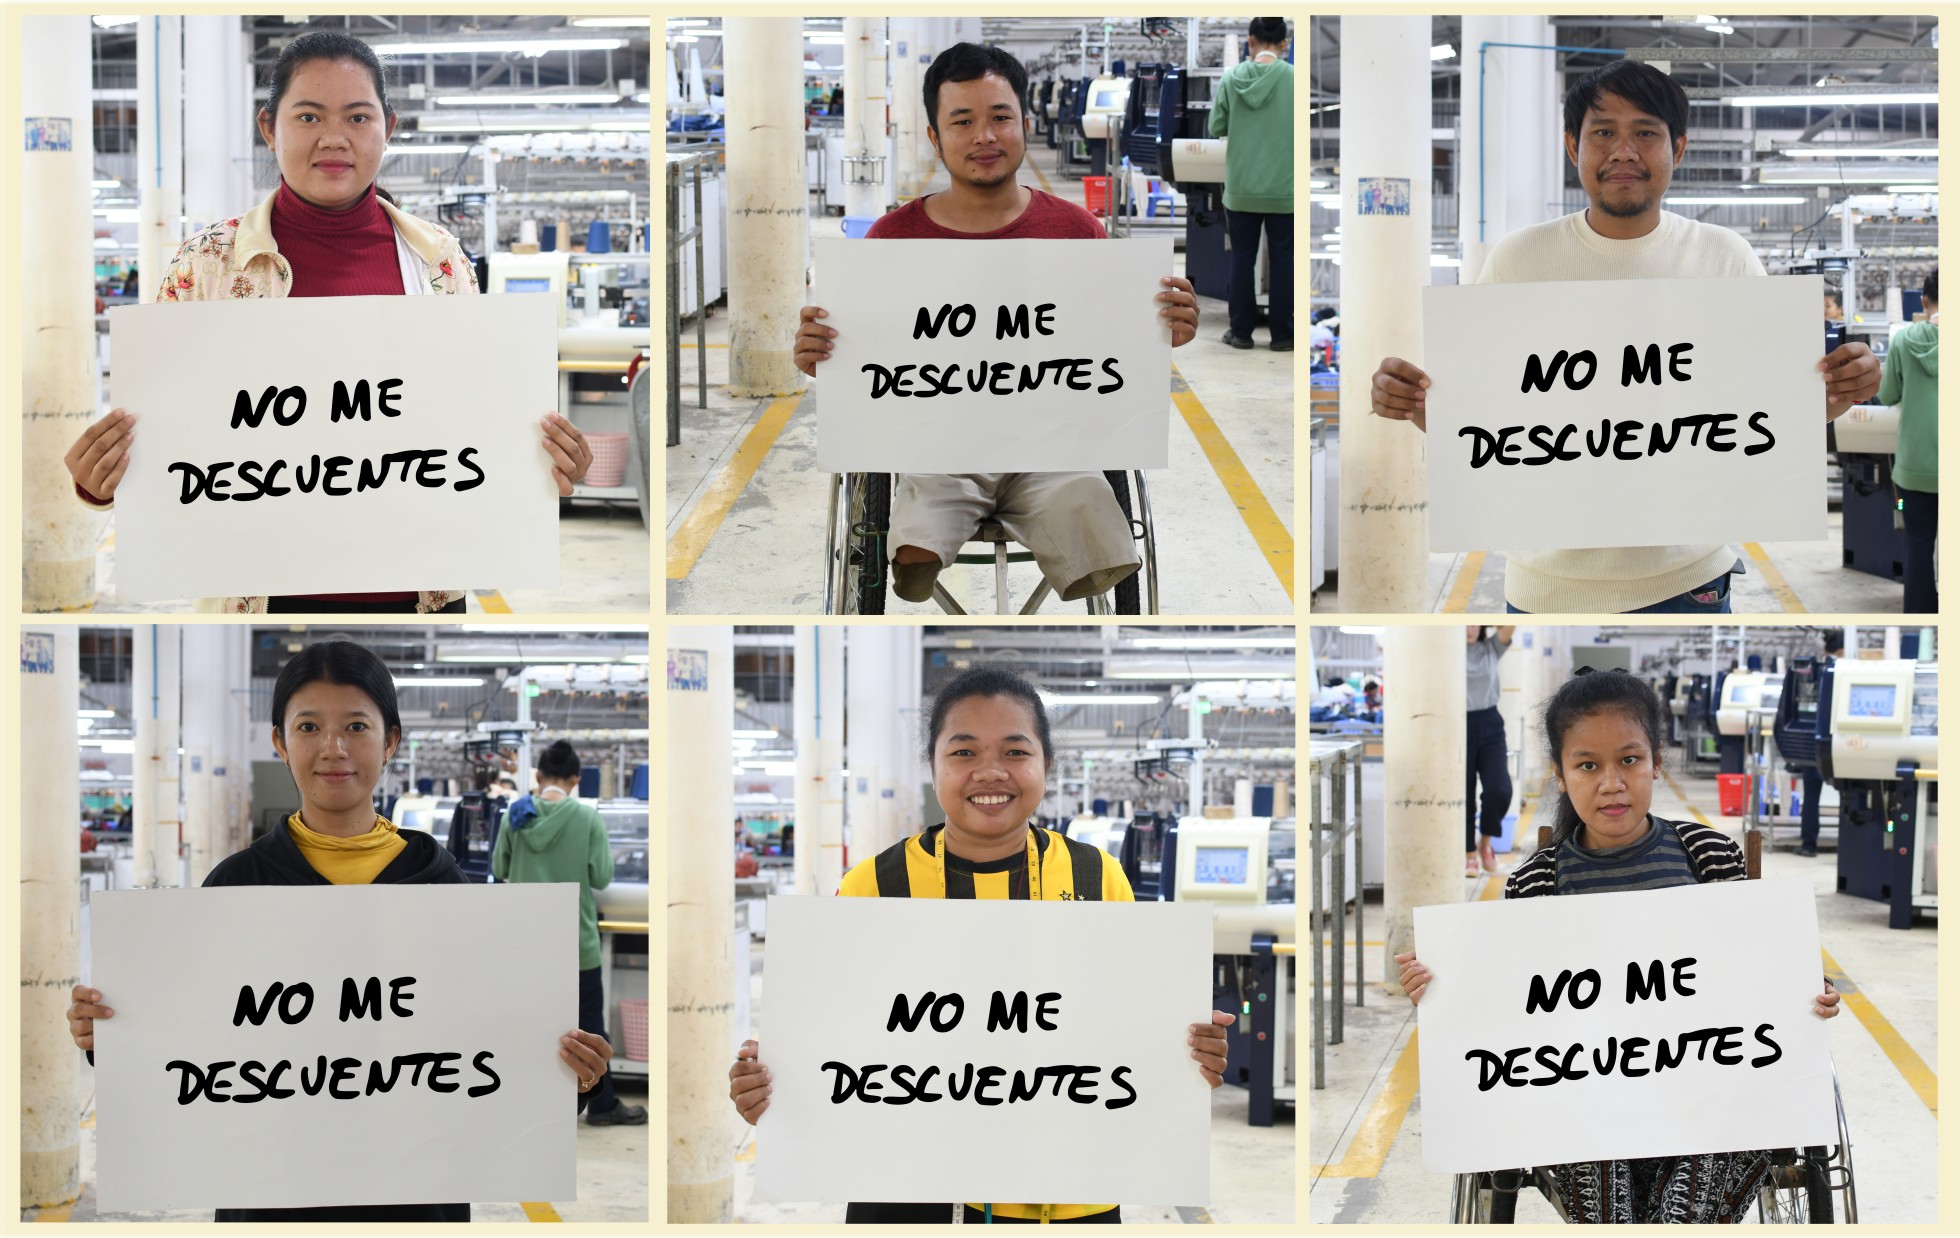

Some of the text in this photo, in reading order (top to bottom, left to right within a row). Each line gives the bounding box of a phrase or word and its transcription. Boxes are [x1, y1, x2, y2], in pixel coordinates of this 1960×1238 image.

[912, 303, 1057, 341] NO ME
[861, 357, 1124, 399] DESCUENTES
[1520, 342, 1694, 394] NO ME
[230, 378, 404, 430] NO ME
[1458, 411, 1776, 469] DESCUENTES
[167, 447, 485, 505] DESCUENTES
[232, 976, 417, 1027] NO ME
[886, 990, 1062, 1034] NO ME
[1525, 957, 1697, 1015] NO ME
[165, 1050, 501, 1106] DESCUENTES
[1464, 1023, 1783, 1092] DESCUENTES
[820, 1061, 1137, 1110] DESCUENTES
